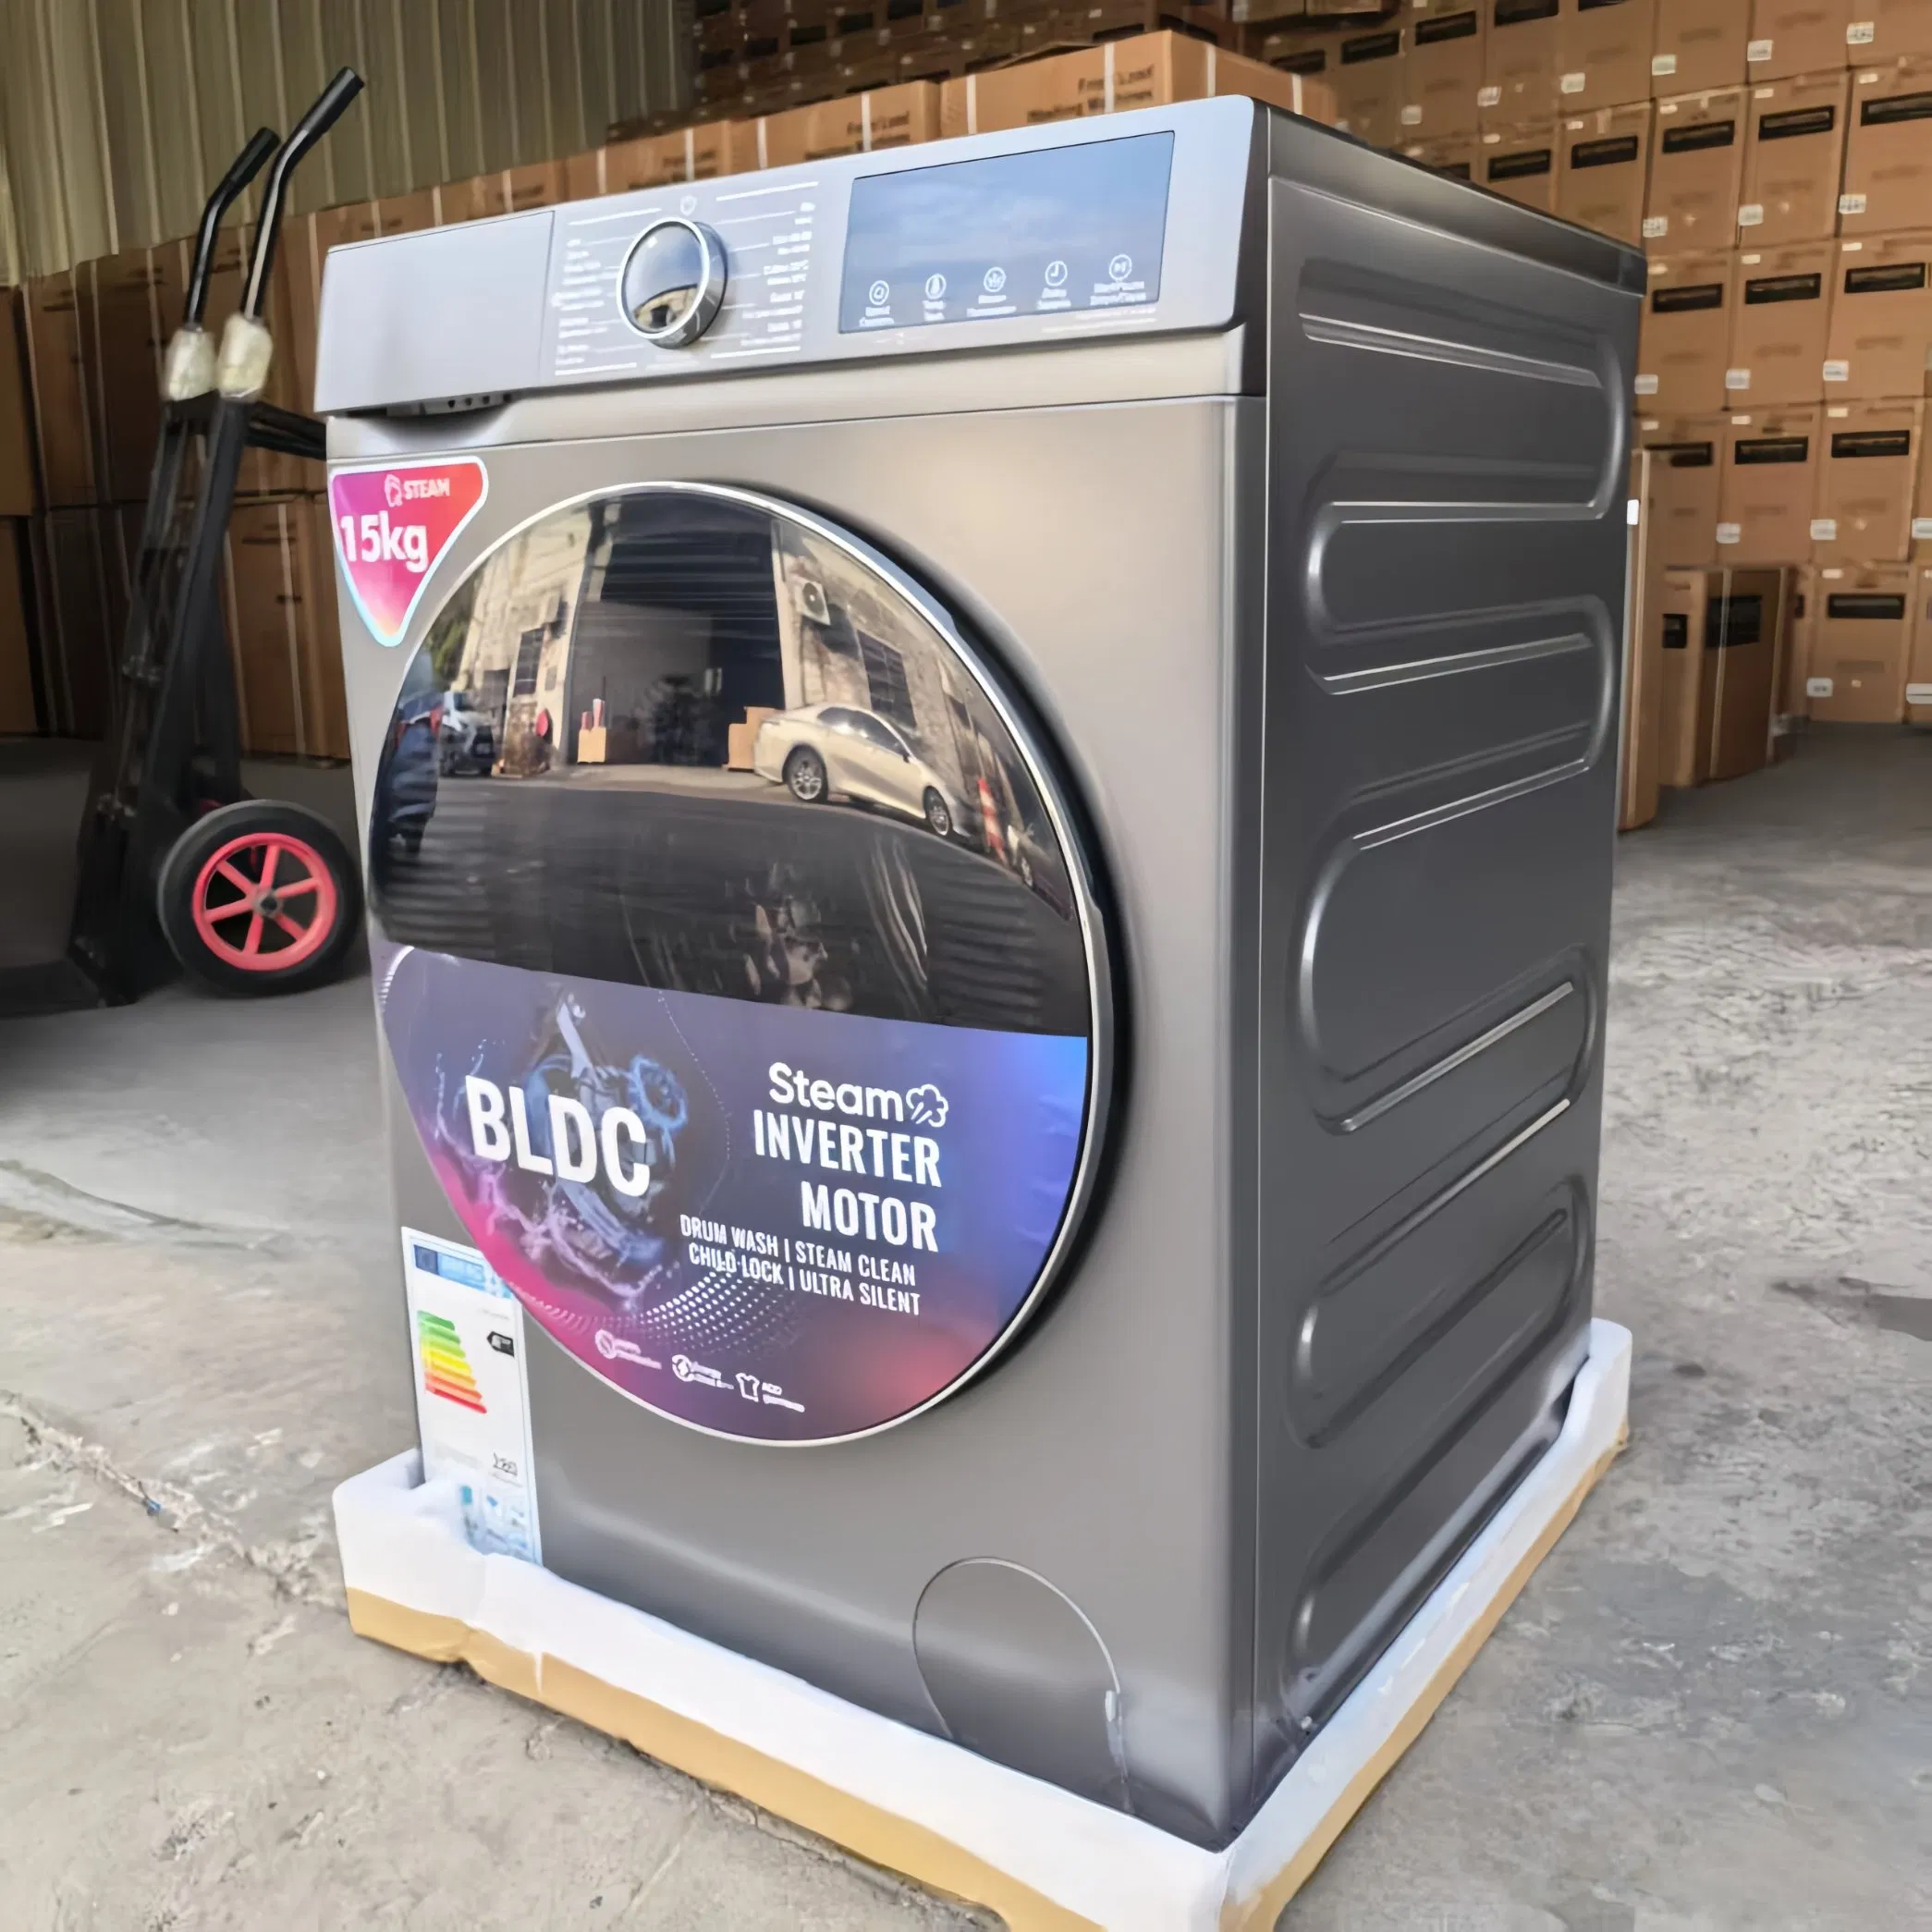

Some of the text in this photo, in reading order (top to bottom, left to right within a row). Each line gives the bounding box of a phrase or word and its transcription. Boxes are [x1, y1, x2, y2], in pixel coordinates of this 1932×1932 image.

[403, 478, 450, 500] STEAM
[340, 510, 429, 573] 15kg
[769, 1062, 904, 1121] Steam
[465, 1075, 650, 1197] BLDC
[753, 1109, 942, 1188] INVERTER
[679, 1214, 916, 1287] DRUM WASH STEAM CLEAN
[801, 1180, 938, 1253] MOTOR
[689, 1242, 921, 1316] CHILD LOCK ULTRA SILENT
